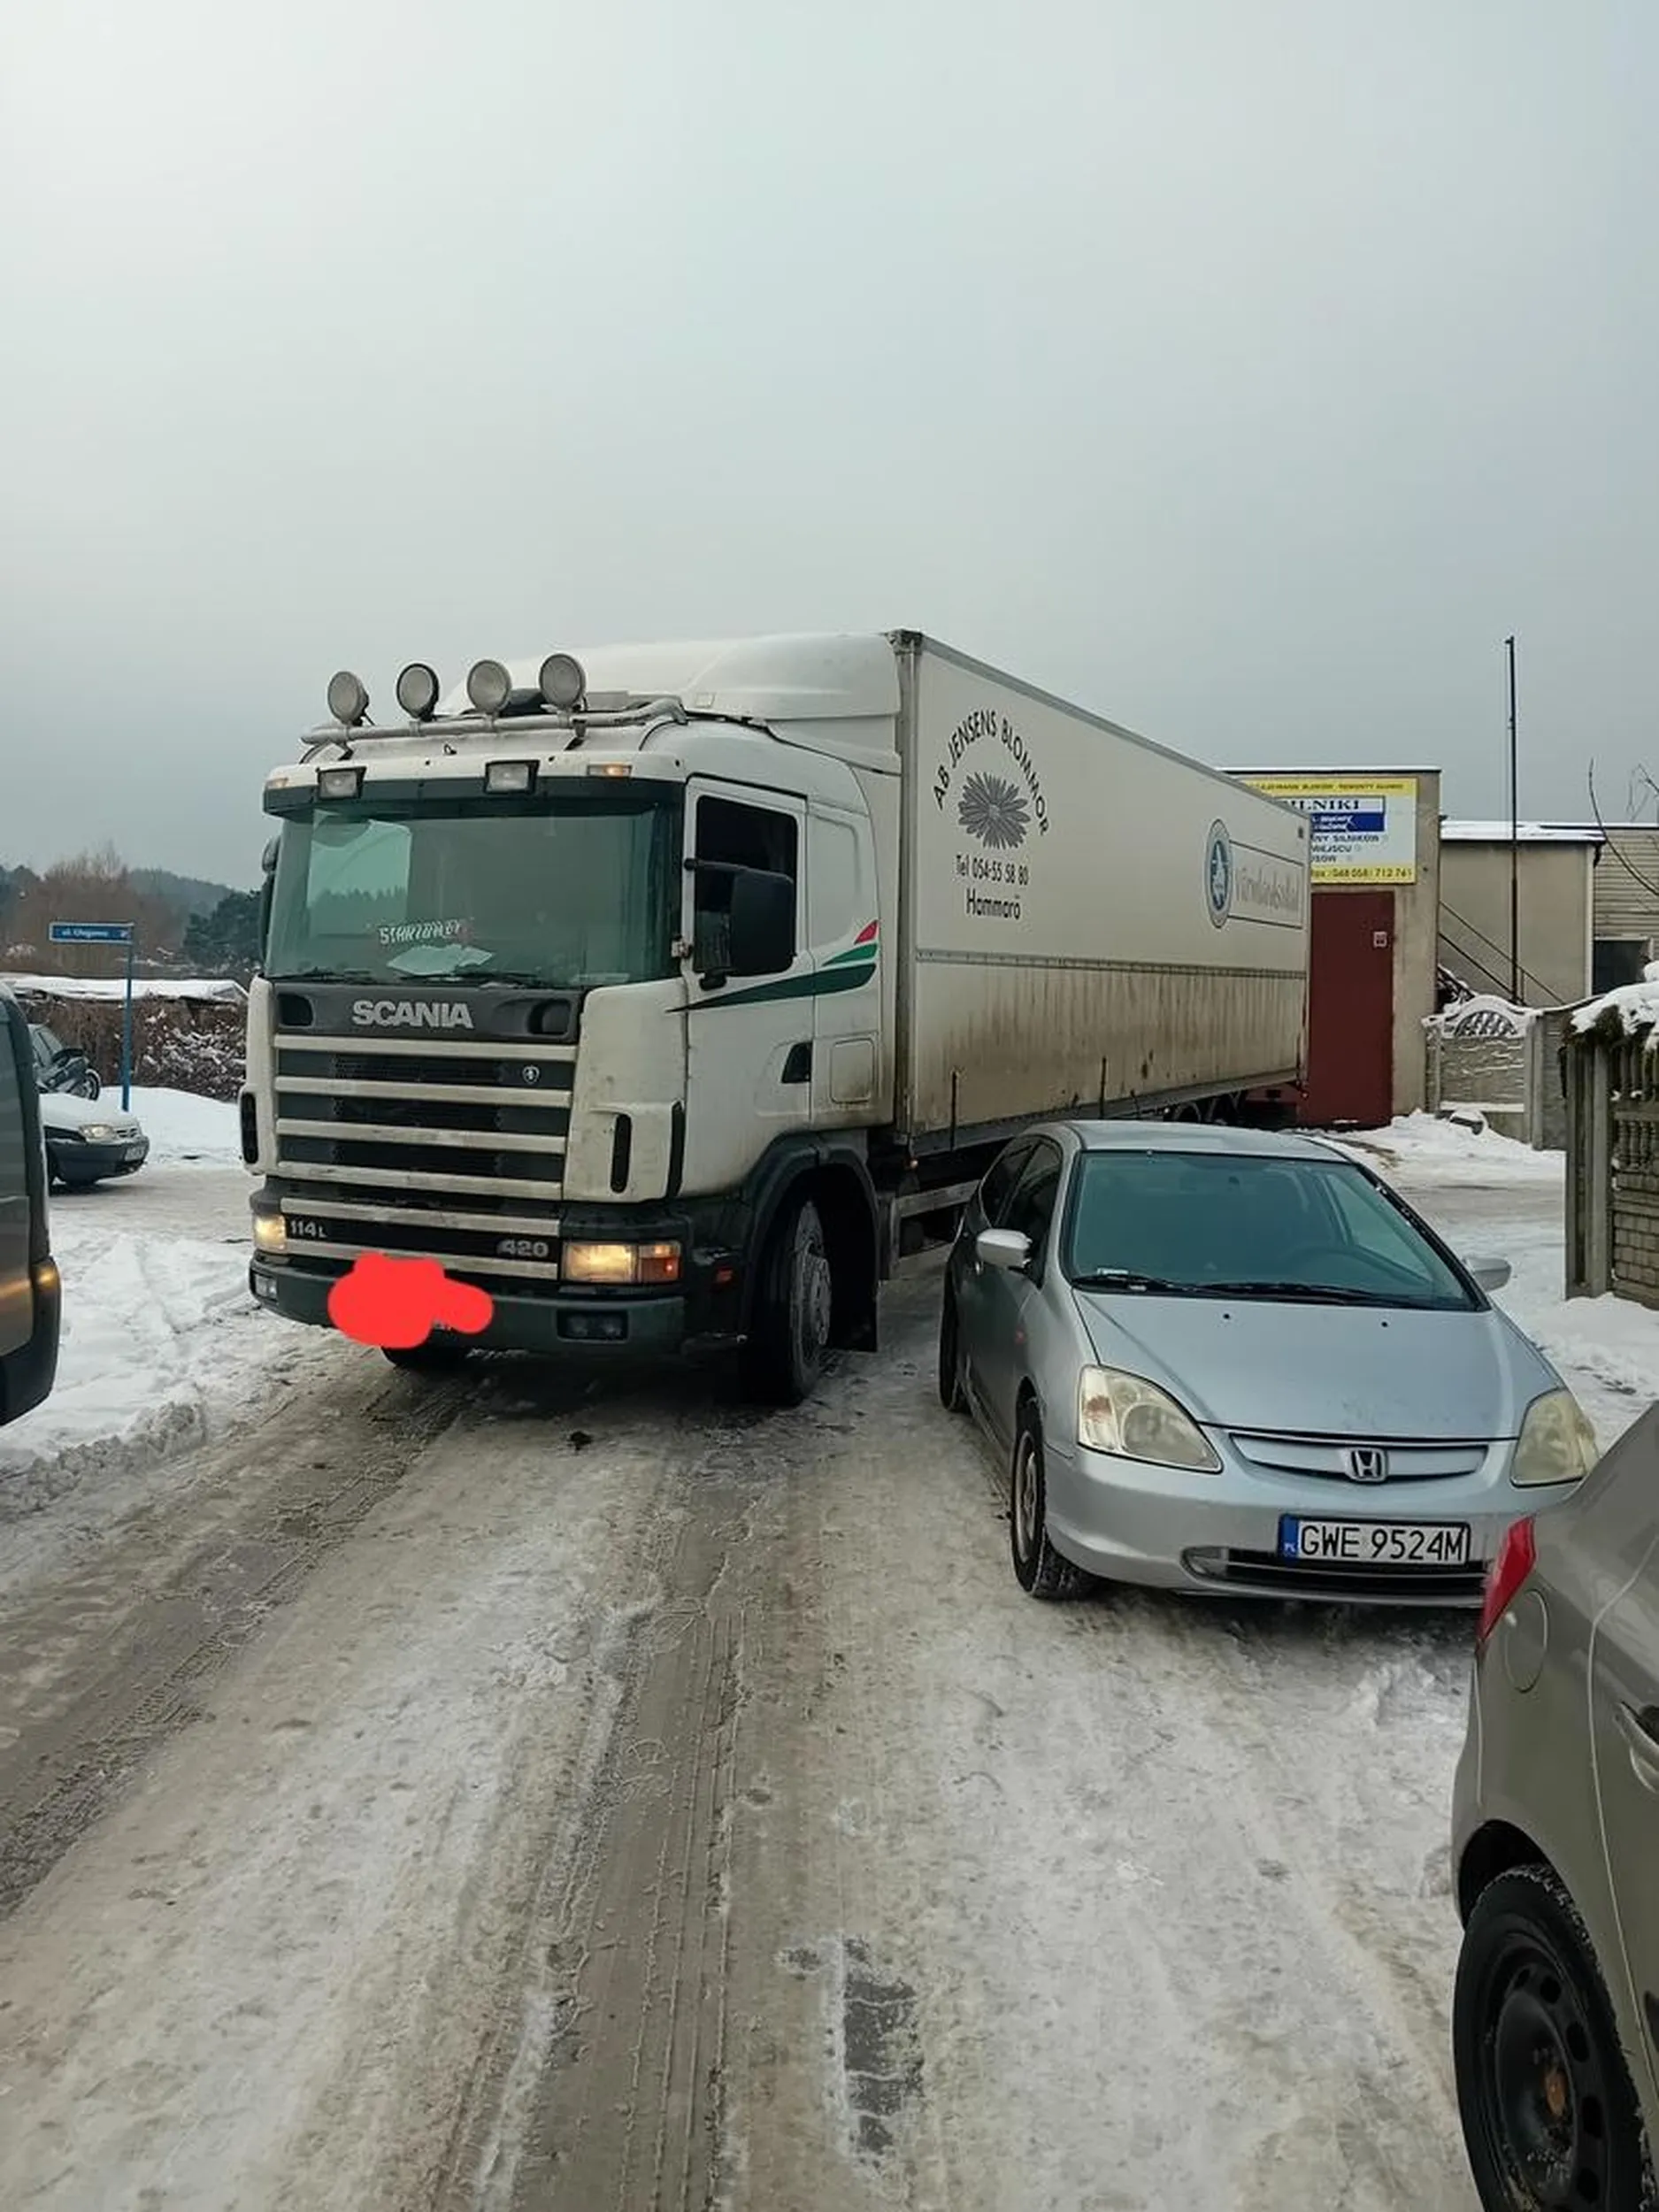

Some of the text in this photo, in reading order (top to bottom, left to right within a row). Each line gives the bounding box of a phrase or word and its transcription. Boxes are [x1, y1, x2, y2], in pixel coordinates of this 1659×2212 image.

[934, 710, 1050, 836] AB JENSENS BLOMMOR
[965, 888, 1021, 920] Hammarö
[352, 1000, 475, 1030] SCANIA
[496, 1239, 549, 1258] 420
[1300, 1525, 1466, 1563] GWE 9524M
